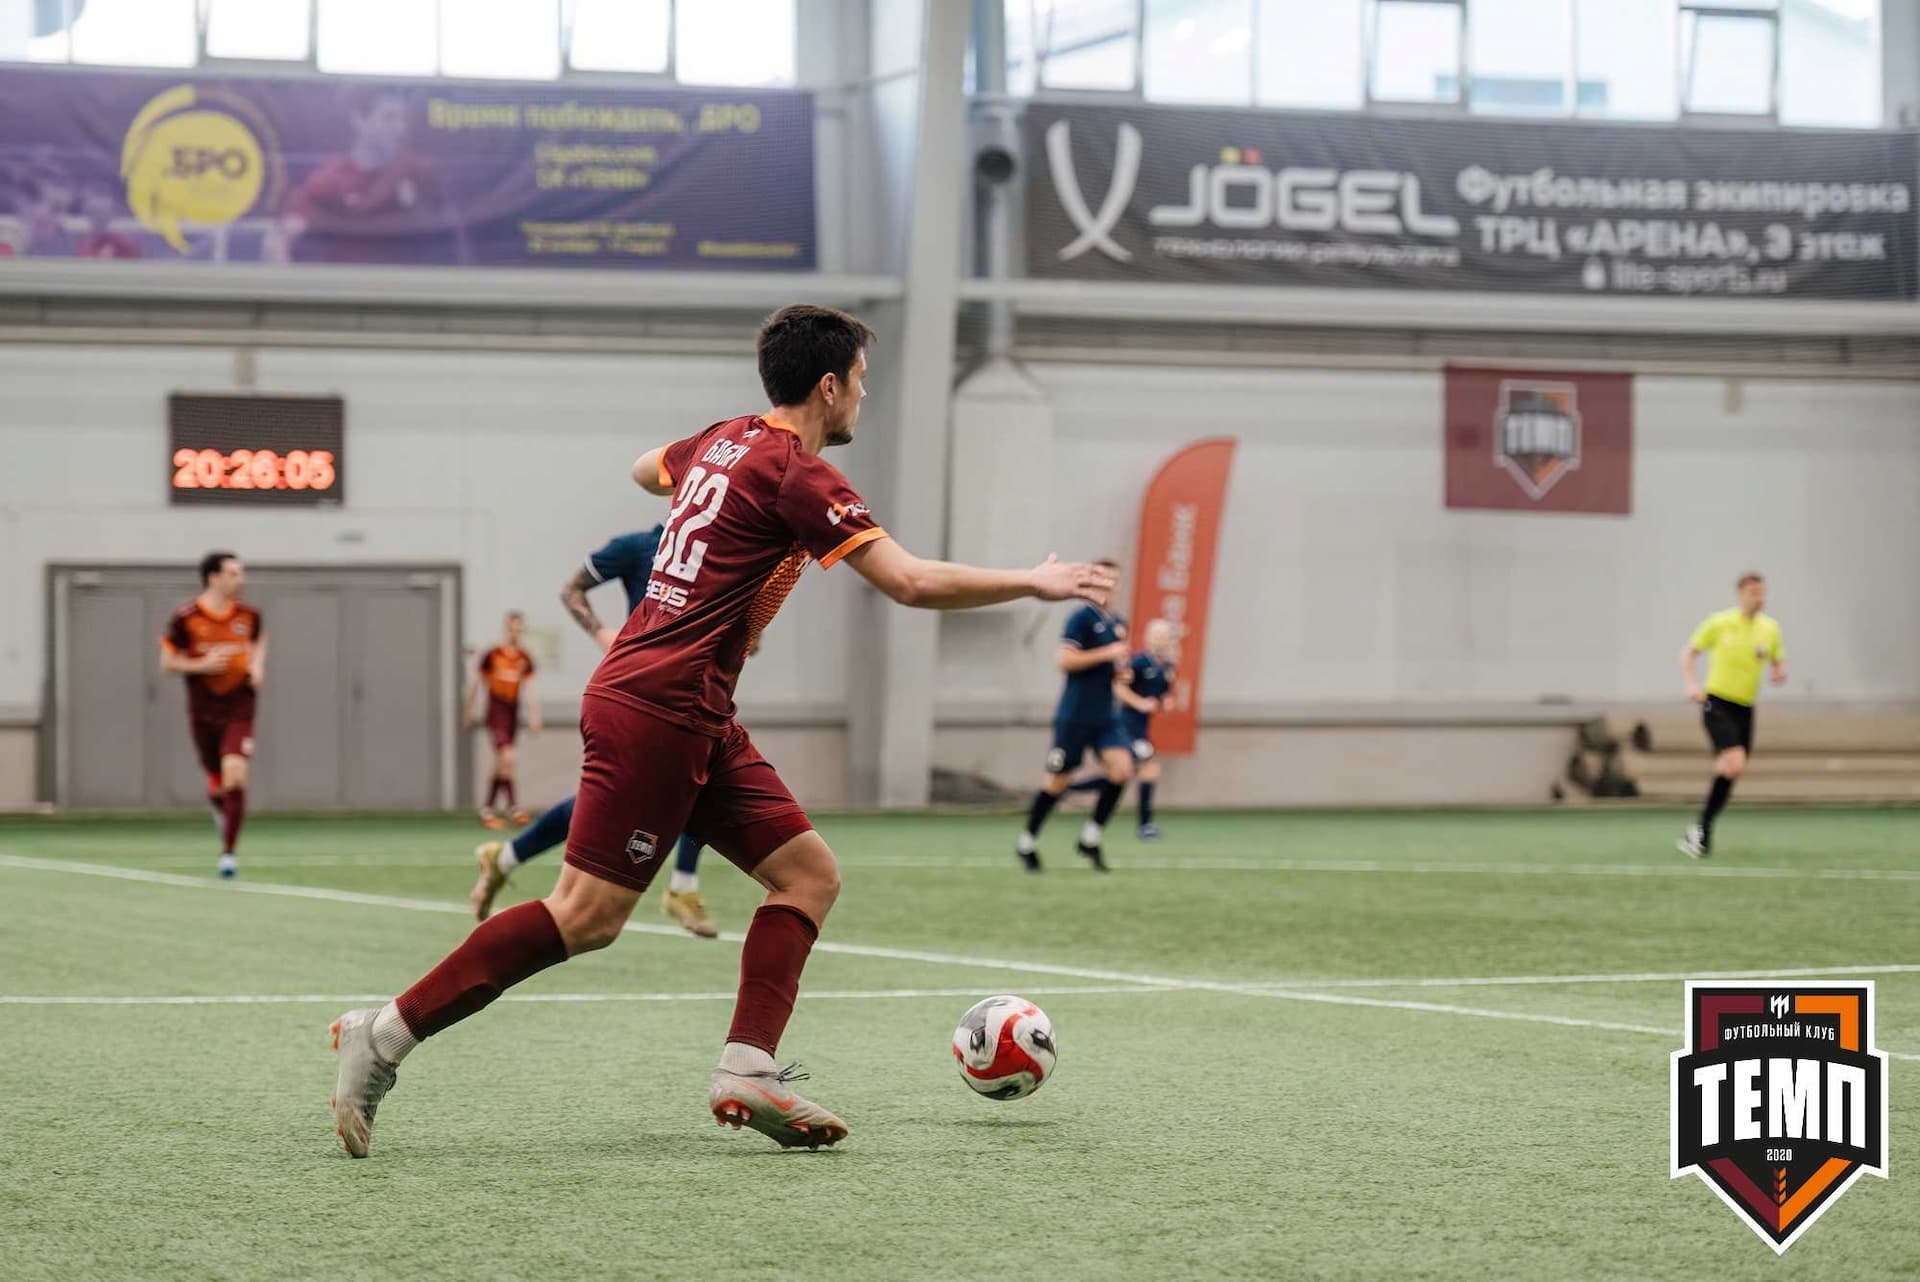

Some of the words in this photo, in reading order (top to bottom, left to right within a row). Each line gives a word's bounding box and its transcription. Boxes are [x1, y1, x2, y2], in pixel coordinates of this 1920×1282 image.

[1456, 165, 1687, 213] Футбольная
[1694, 179, 1909, 219] экипировка
[1475, 215, 1561, 259] ТРЦ
[1565, 219, 1759, 264] «АРЕНА»,
[1764, 223, 1793, 260] 3
[1798, 231, 1886, 261] этаж
[1505, 411, 1573, 455] ТЕМП
[652, 466, 729, 583] 22
